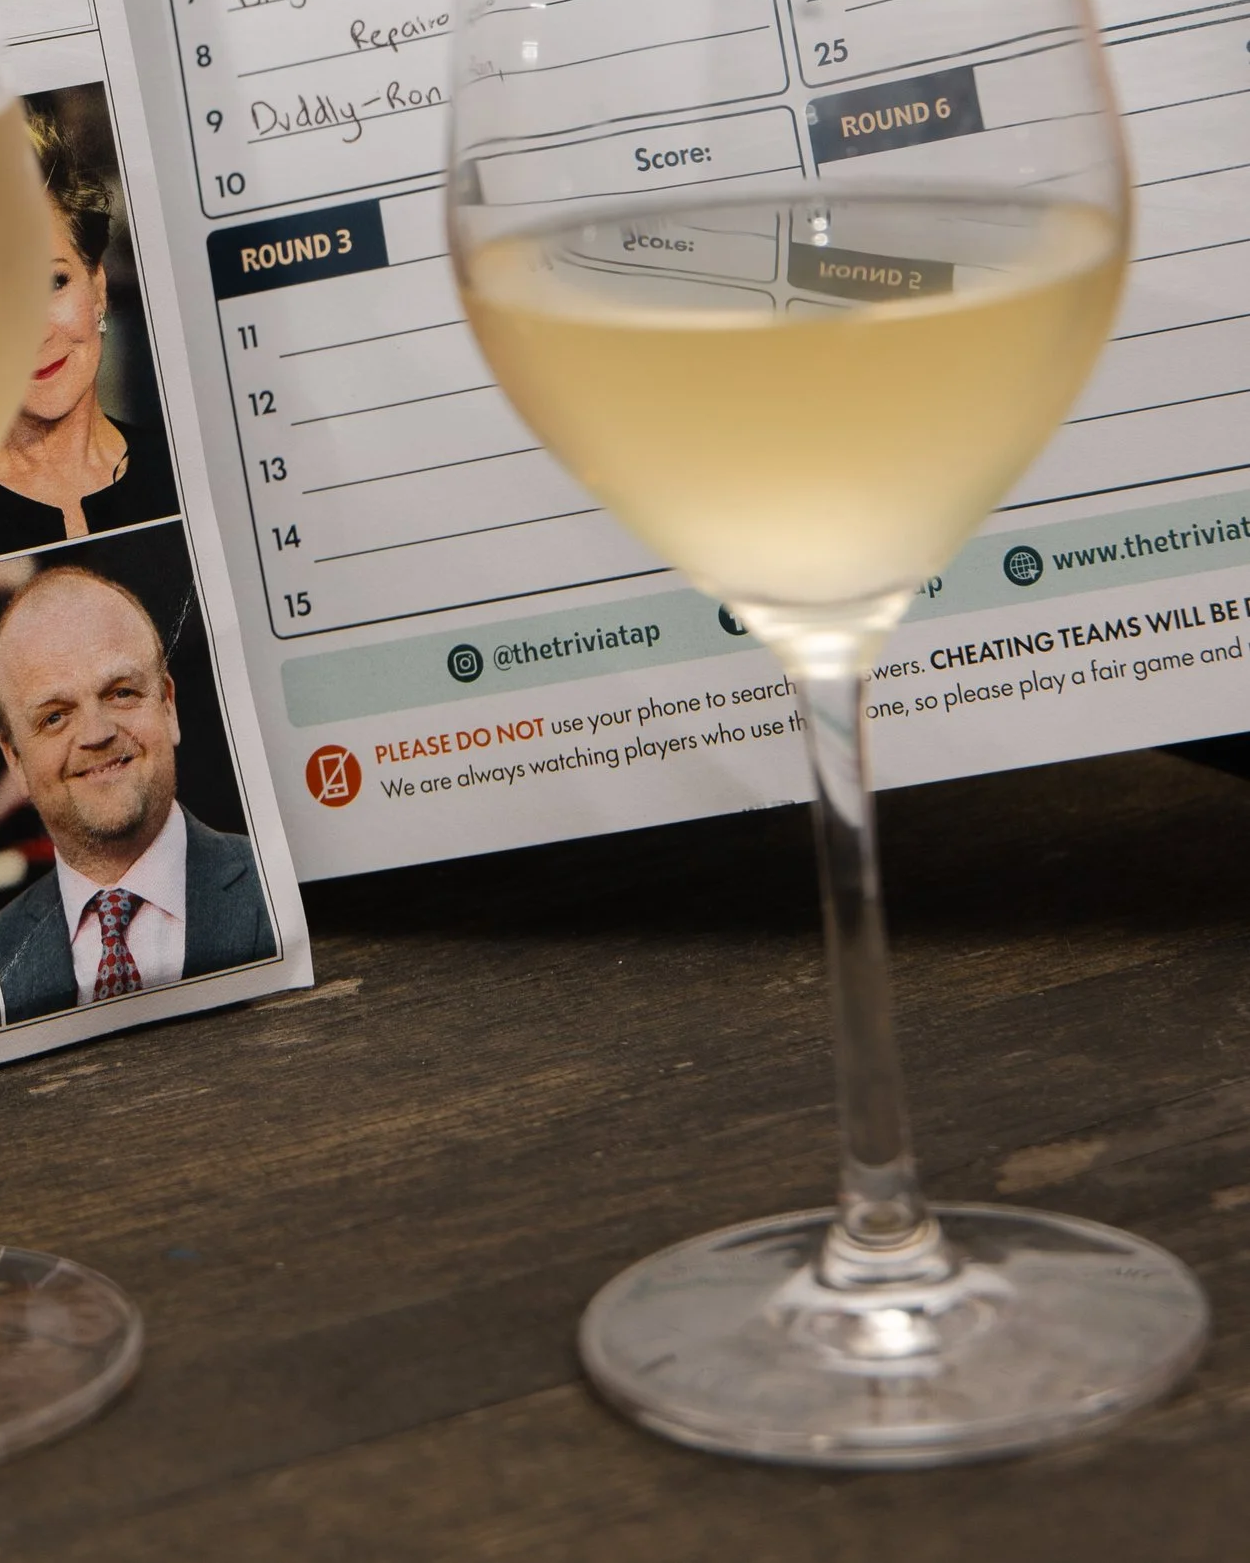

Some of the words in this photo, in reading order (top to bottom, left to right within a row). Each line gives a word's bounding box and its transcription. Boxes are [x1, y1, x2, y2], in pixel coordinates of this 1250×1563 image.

[196, 44, 212, 68] 8
[814, 38, 849, 67] 25
[205, 109, 224, 134] 9
[841, 102, 930, 138] ROUND
[634, 147, 712, 172] Score:
[215, 172, 246, 198] 10
[241, 235, 331, 273] ROUND
[237, 324, 258, 350] 11
[248, 390, 277, 417] 12
[259, 456, 288, 484] 13
[271, 524, 302, 552] 14
[1053, 513, 1250, 571] www.thetriviat
[283, 591, 312, 619] 15
[493, 623, 661, 670] @thetriviatap
[374, 733, 453, 765] PLEASE
[455, 727, 492, 751] DO
[496, 717, 545, 744] NOT
[551, 717, 584, 735] use
[586, 708, 632, 735] your
[637, 696, 701, 727] phone
[705, 691, 726, 709] to
[929, 631, 1055, 670] CHEATING
[1057, 616, 1142, 649] TEAMS
[1144, 606, 1206, 634] WILL
[1209, 599, 1240, 624] BE
[380, 777, 415, 799] We
[420, 776, 452, 794] are
[457, 764, 526, 788] always
[528, 746, 620, 775] watching
[624, 735, 698, 766] players
[700, 722, 746, 746] who
[750, 721, 784, 739] use
[914, 695, 938, 712] so
[943, 682, 1014, 713] please
[1018, 669, 1066, 701] play
[1071, 670, 1086, 685] a
[1090, 659, 1127, 682] fair
[1132, 652, 1195, 681] game
[1200, 635, 1243, 664] and
